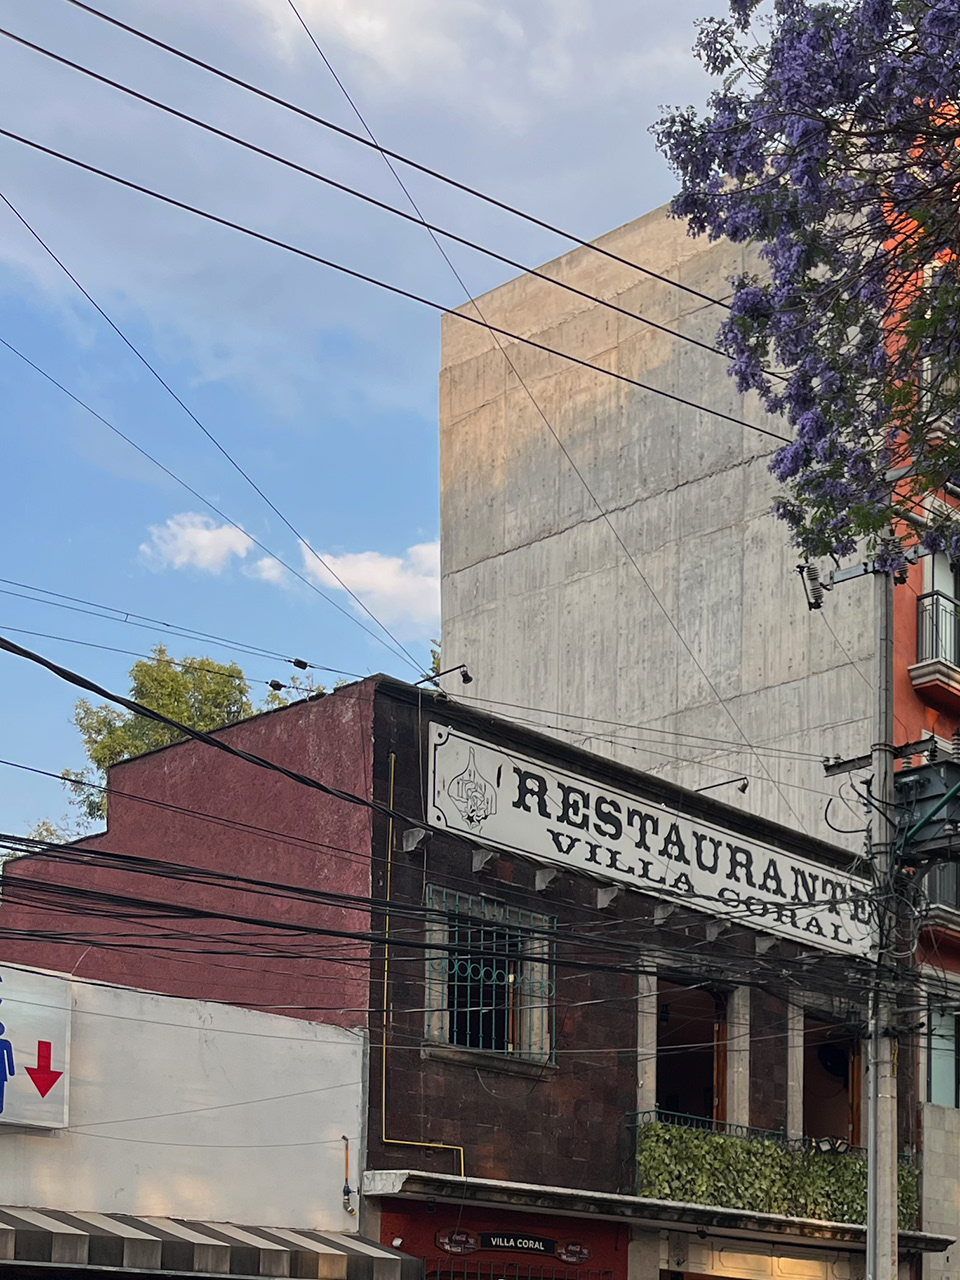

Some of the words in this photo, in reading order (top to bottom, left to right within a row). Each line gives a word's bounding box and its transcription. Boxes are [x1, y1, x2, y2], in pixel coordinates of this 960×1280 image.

[511, 766, 872, 926] RESTAURANTE
[546, 828, 698, 894] VILLA
[718, 886, 854, 946] CORAL
[490, 1237, 515, 1247] VILLA
[517, 1238, 545, 1250] CORAL
